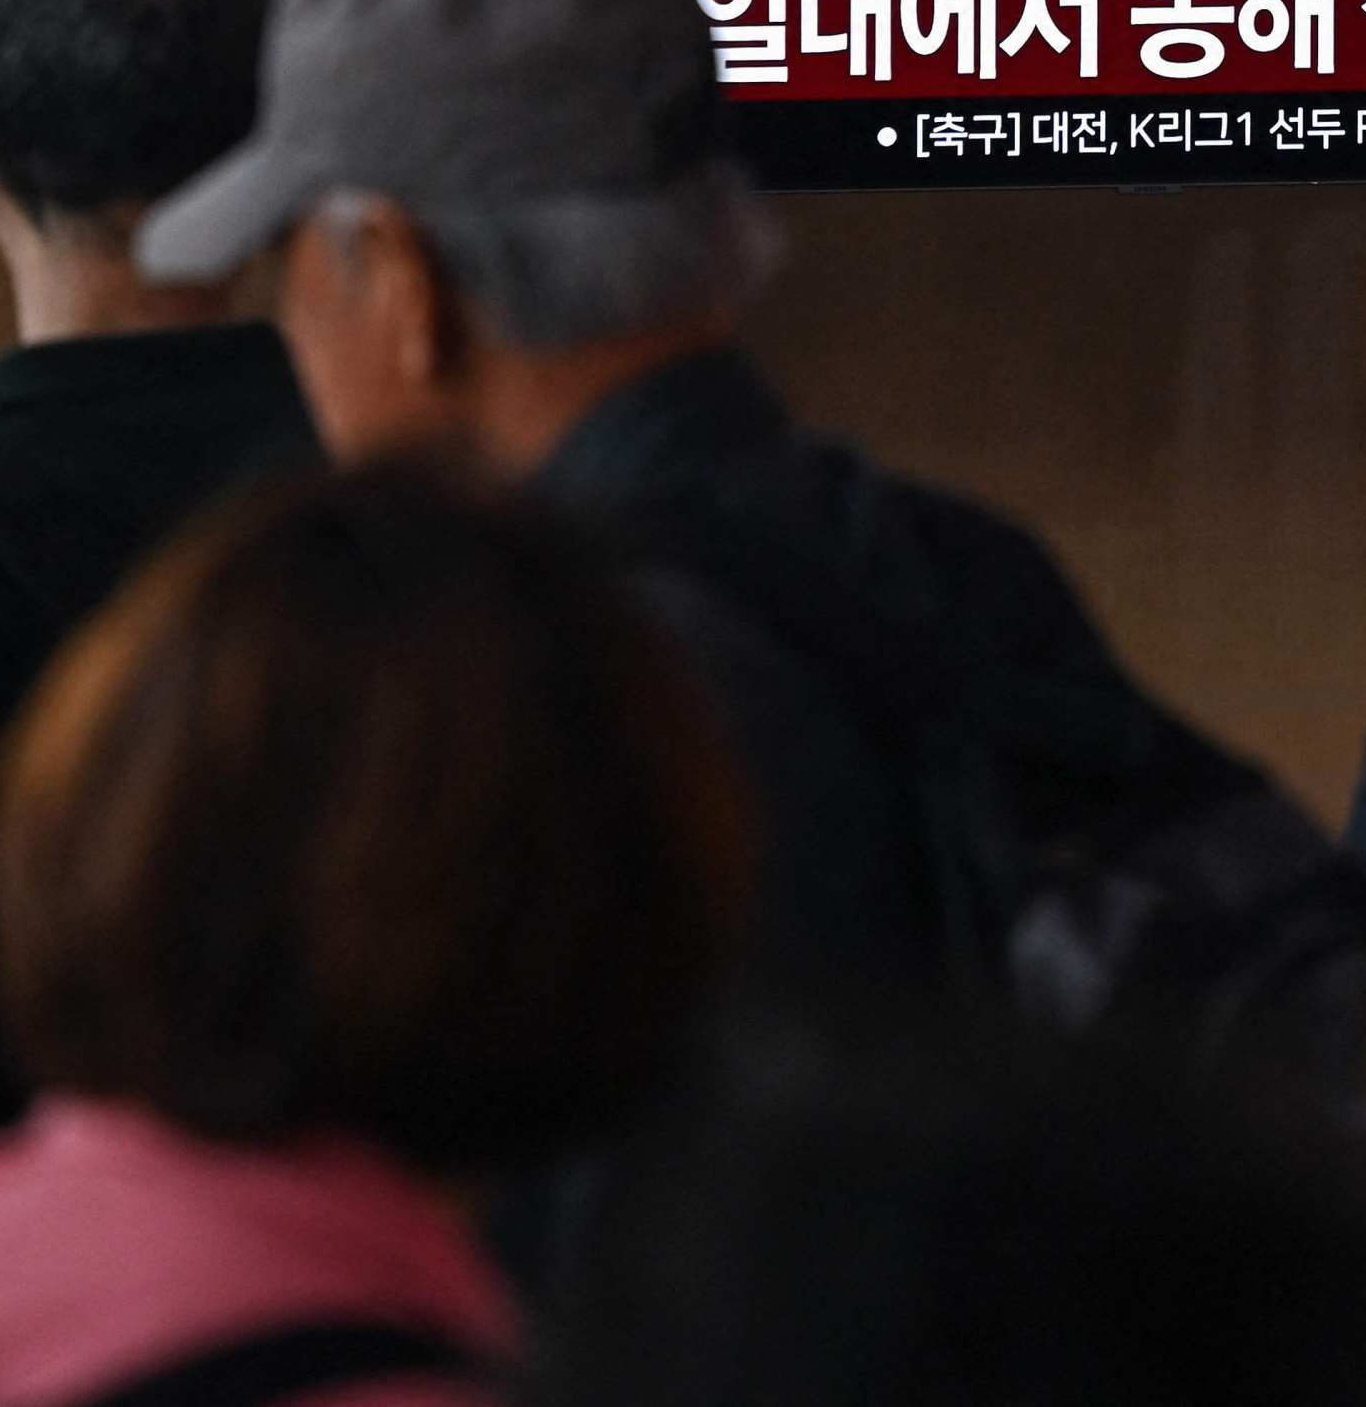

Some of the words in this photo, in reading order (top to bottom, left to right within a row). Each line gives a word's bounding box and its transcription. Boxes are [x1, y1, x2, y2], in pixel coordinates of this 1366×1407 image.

[916, 112, 1021, 158] [축구]
[1032, 110, 1118, 156] 대전,
[1130, 108, 1251, 152] K리그1
[1269, 106, 1346, 150] 선두
